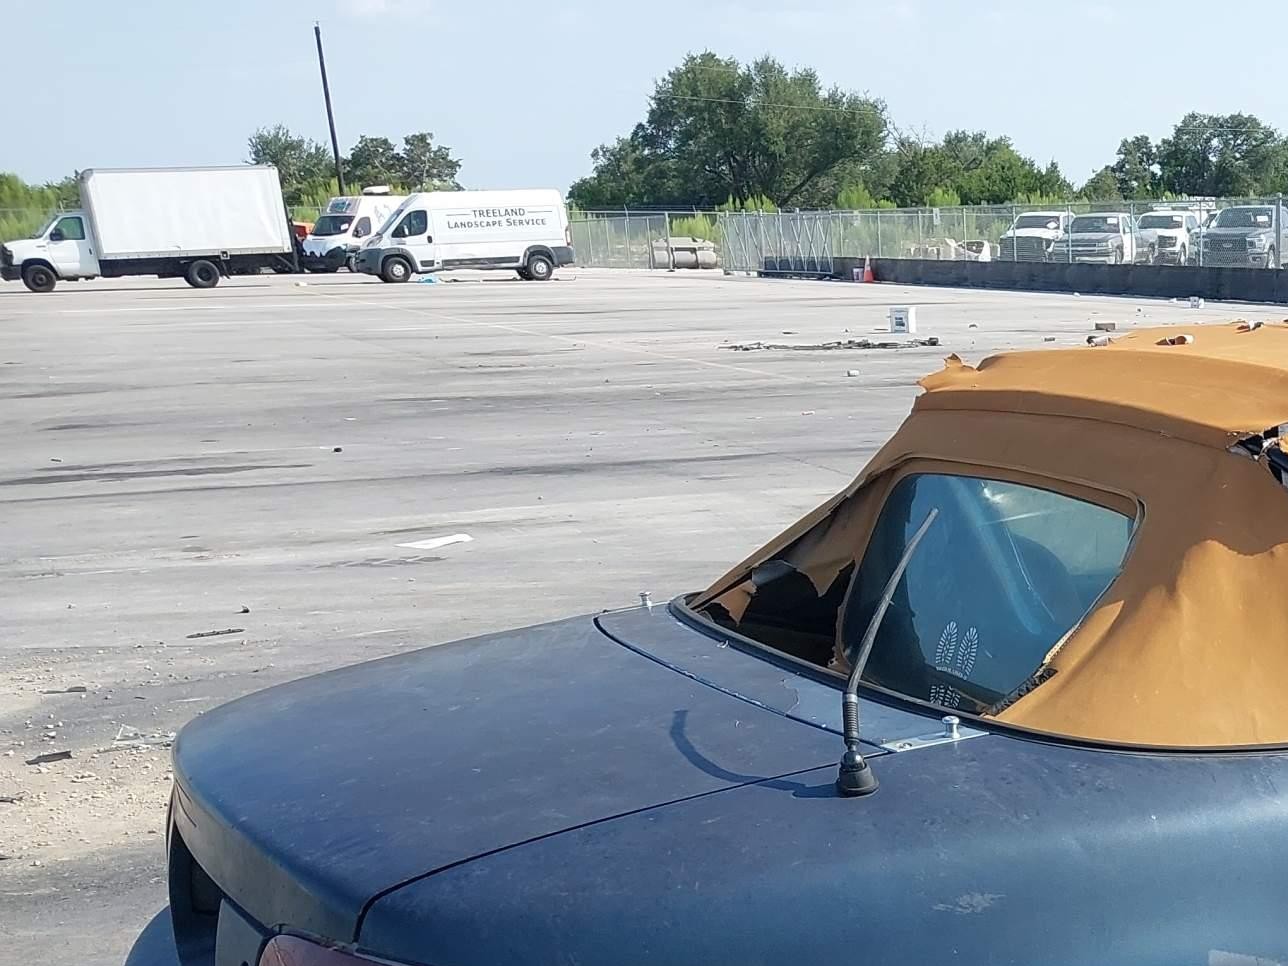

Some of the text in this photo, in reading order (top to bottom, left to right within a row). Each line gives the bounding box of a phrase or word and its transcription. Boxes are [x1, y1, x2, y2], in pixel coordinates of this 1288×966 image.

[472, 207, 526, 218] TREELAND
[447, 217, 547, 229] LANDSCAPE SERVICE
